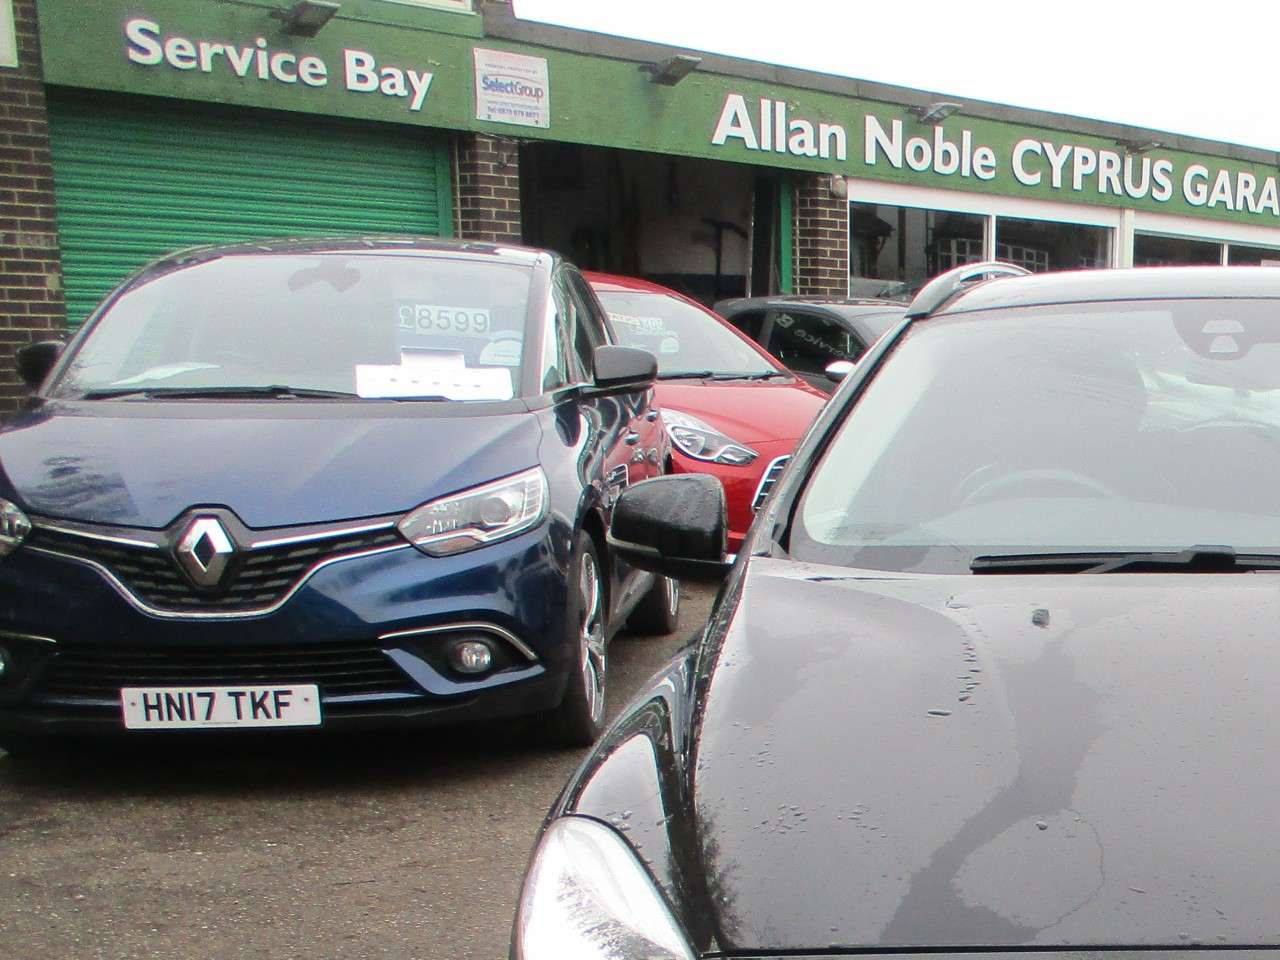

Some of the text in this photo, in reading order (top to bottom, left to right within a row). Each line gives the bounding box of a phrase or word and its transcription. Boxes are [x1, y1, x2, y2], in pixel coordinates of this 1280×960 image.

[124, 19, 434, 112] Service Bay
[711, 92, 847, 162] Allan
[864, 114, 996, 180] Noble
[1011, 138, 1174, 204] CYPRUS
[400, 304, 488, 334] £8599
[142, 689, 293, 722] HN17 TKF
